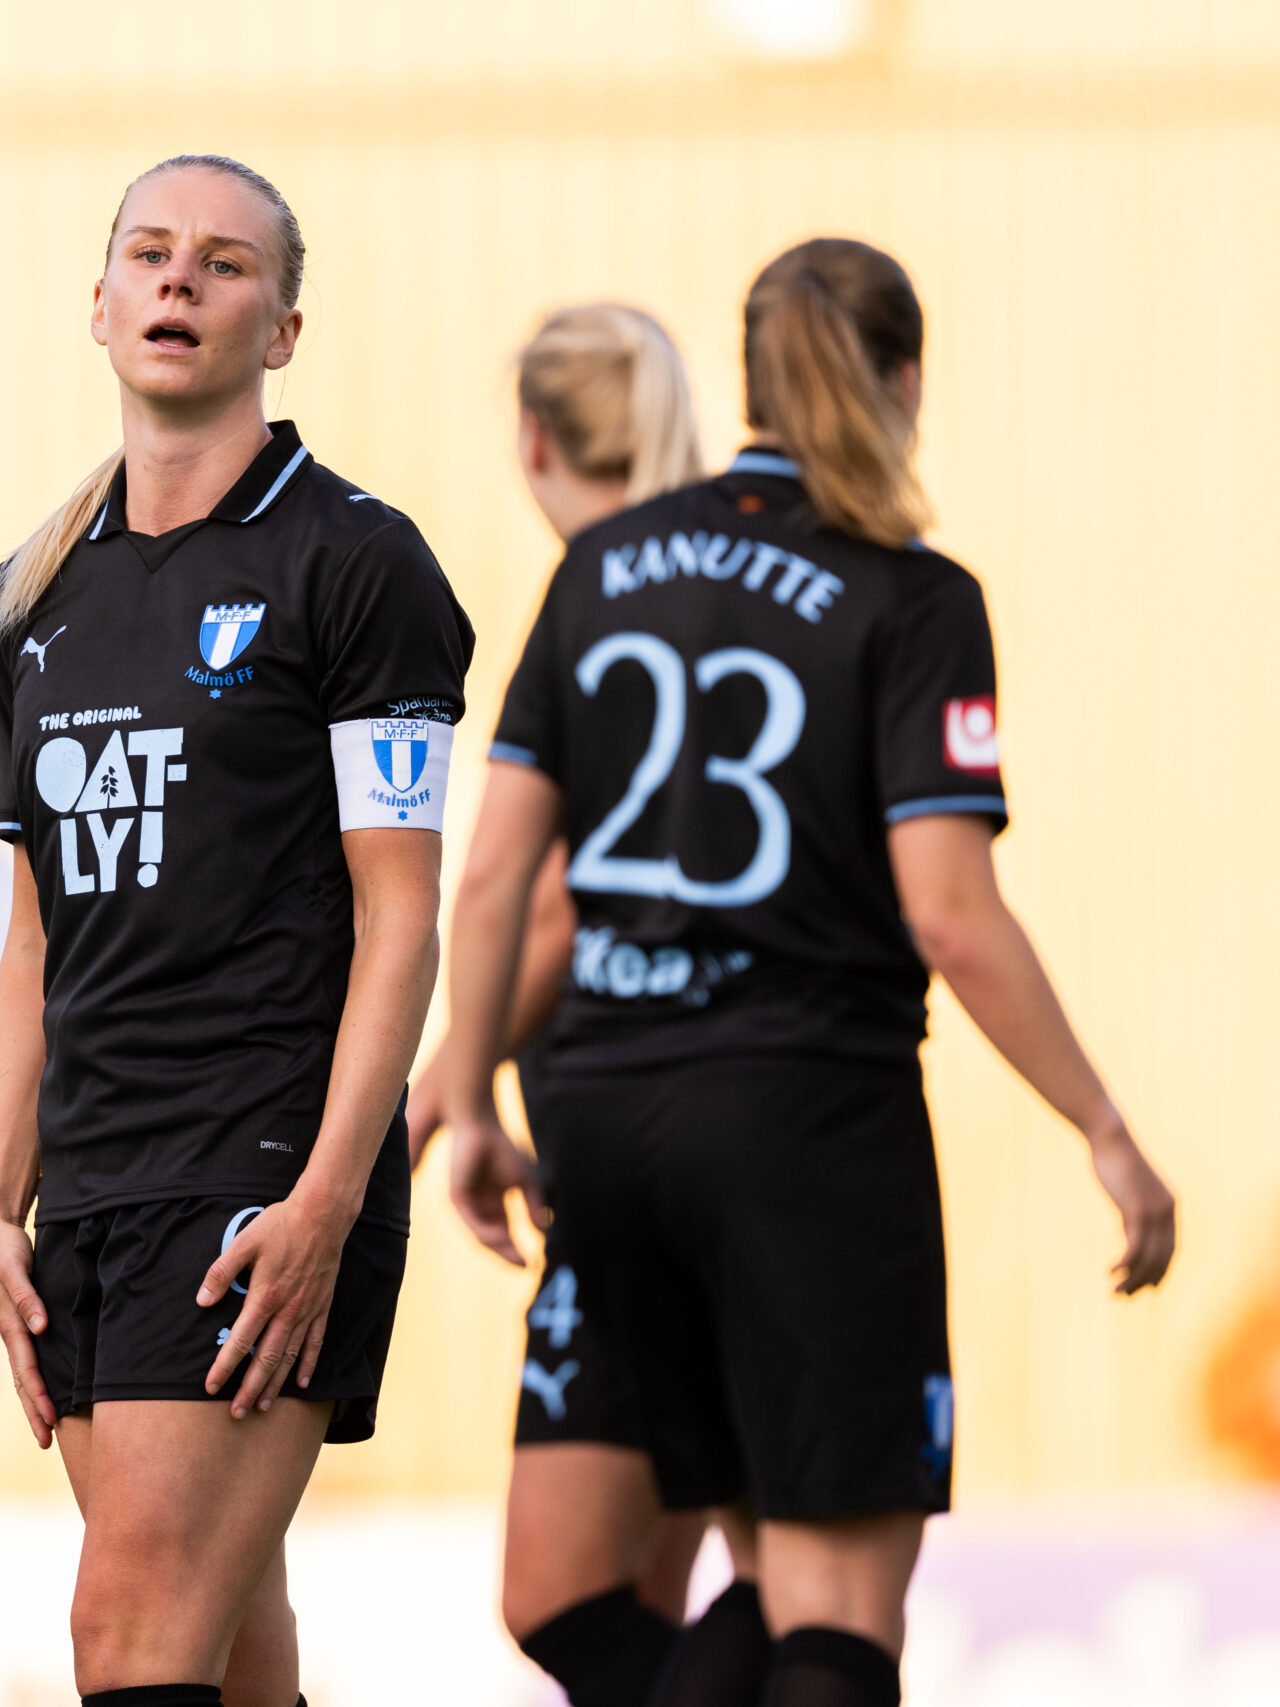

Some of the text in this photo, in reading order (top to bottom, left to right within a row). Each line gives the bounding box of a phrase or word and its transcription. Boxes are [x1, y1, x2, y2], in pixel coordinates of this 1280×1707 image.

[602, 531, 843, 622] KANUTTE
[184, 666, 253, 686] Malmö FF
[39, 706, 142, 732] THE ORIGINAL
[567, 632, 805, 906] 23
[368, 788, 430, 807] Malmö FF
[60, 811, 164, 896] LY!
[260, 1140, 294, 1152] DRYCELL
[529, 1266, 583, 1349] 4
